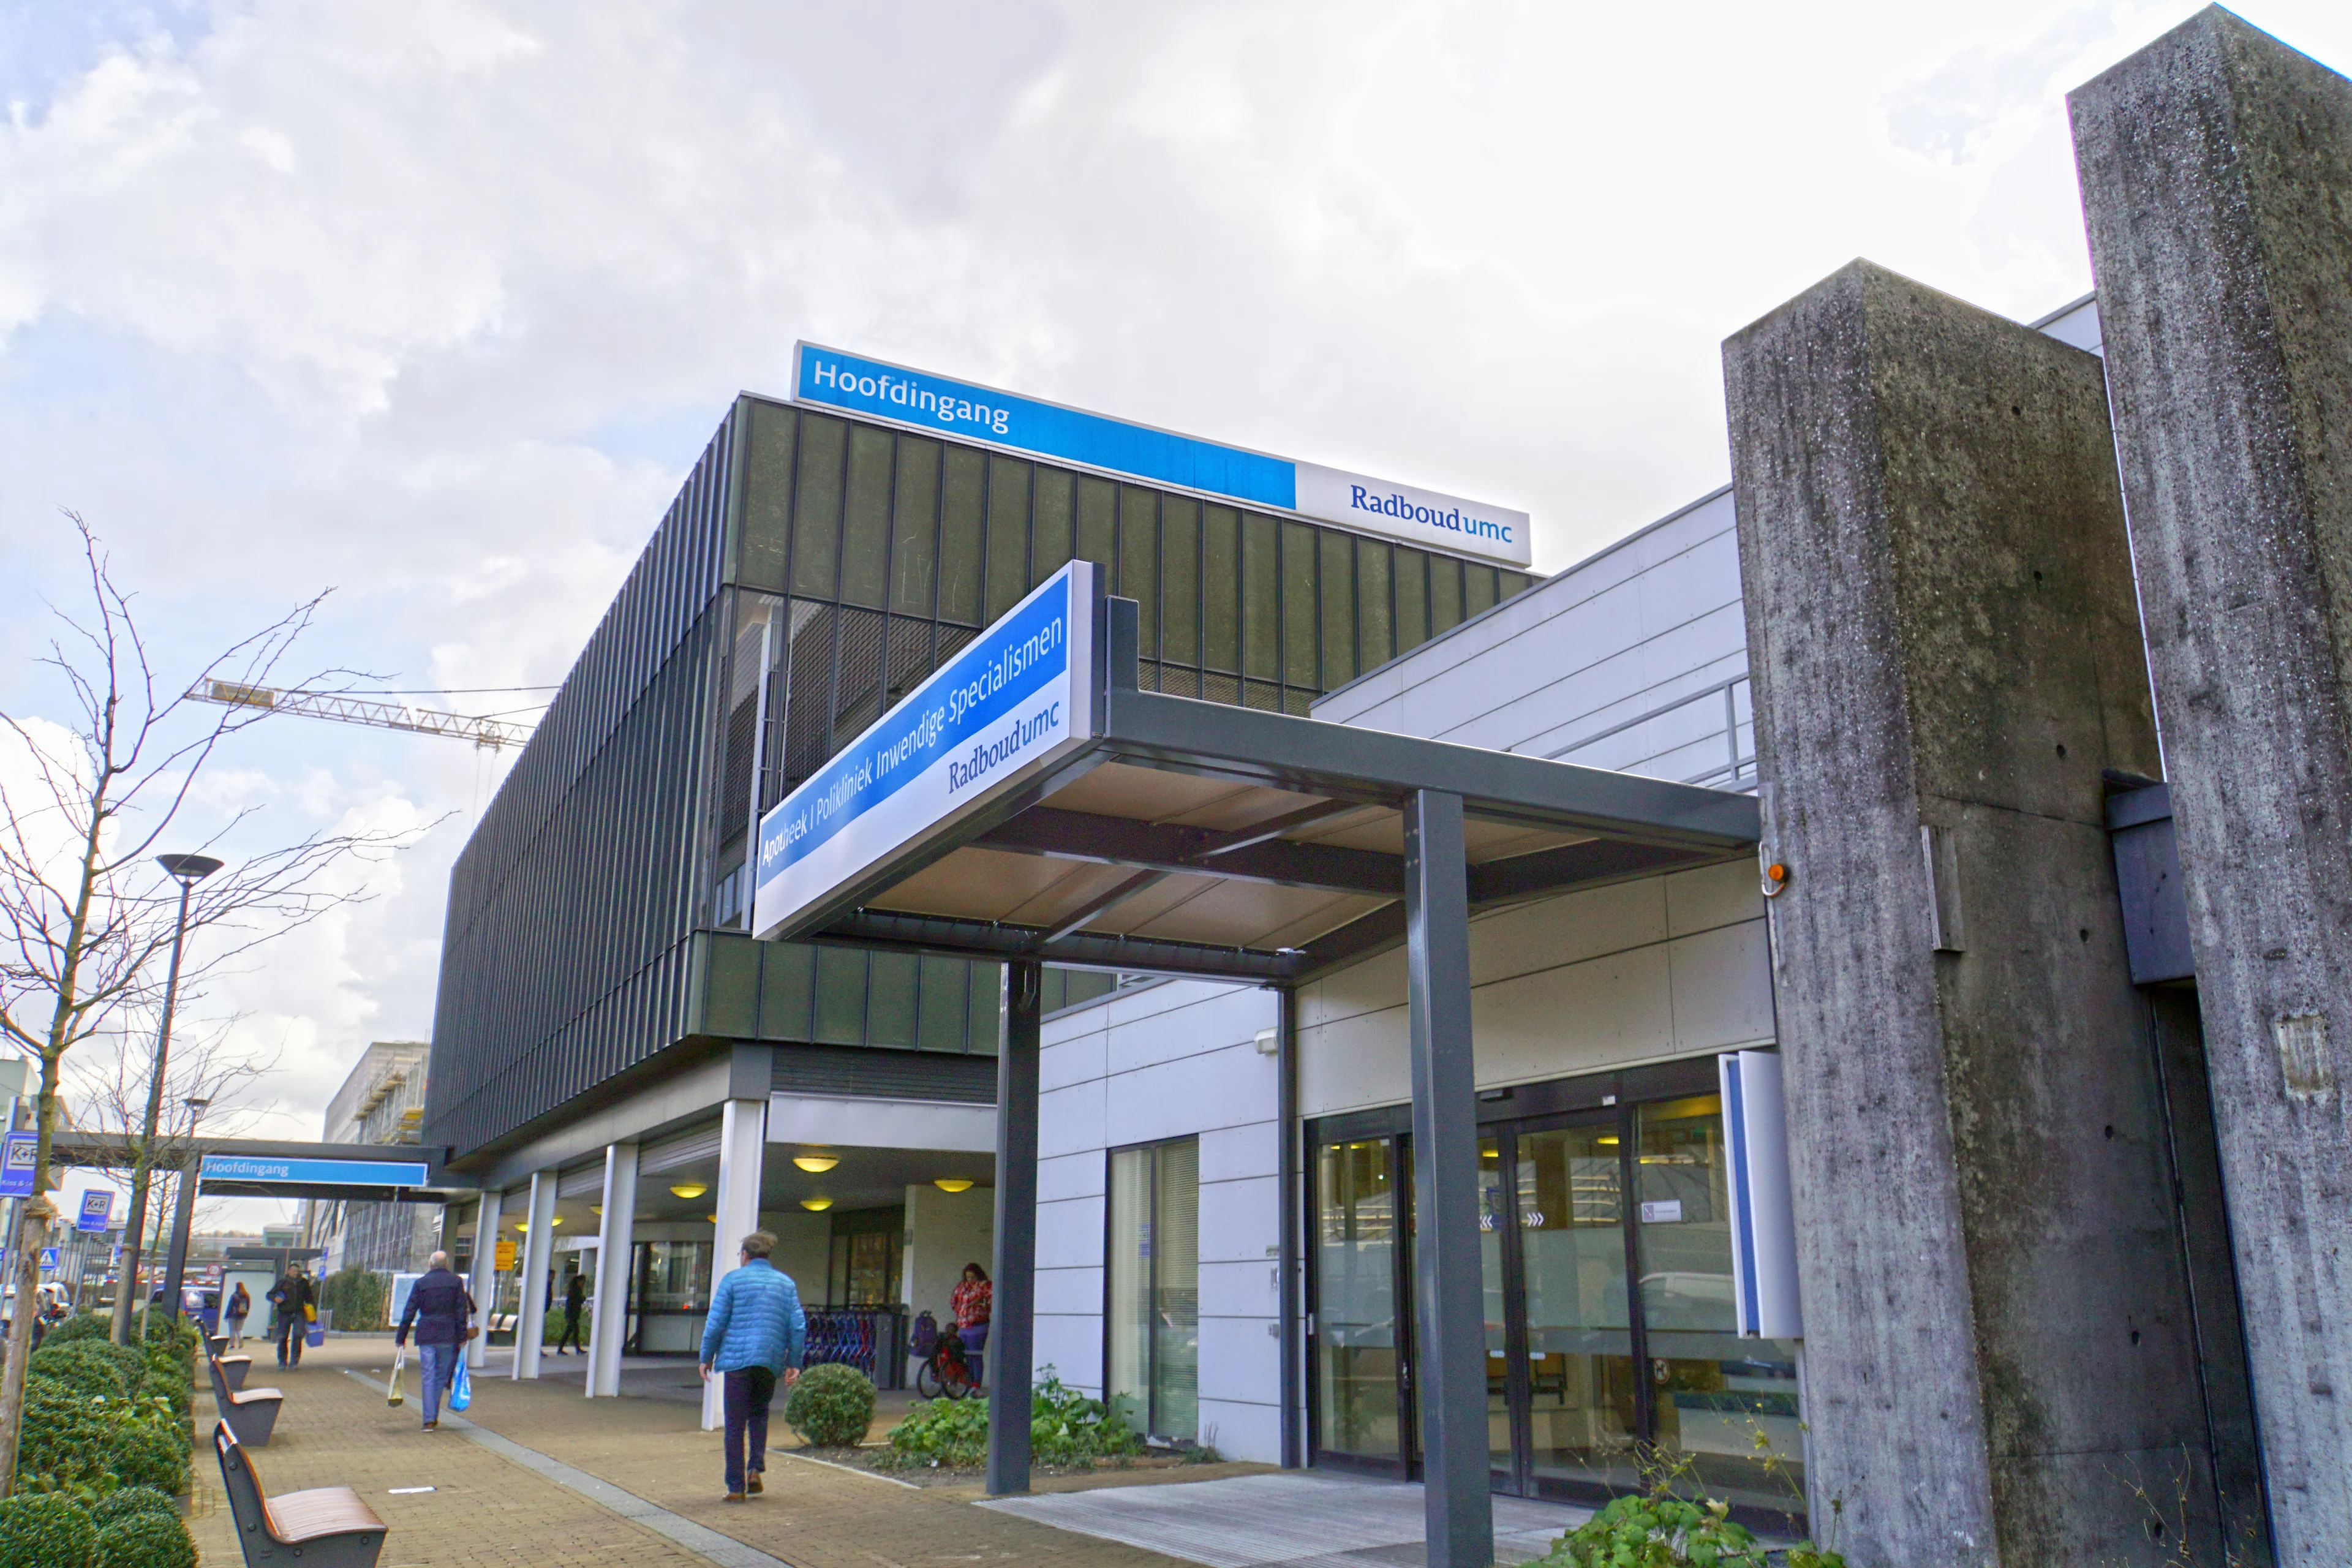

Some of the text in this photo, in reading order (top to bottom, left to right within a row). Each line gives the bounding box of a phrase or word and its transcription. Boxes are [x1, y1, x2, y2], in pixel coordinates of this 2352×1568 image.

[815, 360, 1009, 434] Hoofdingang
[1350, 484, 1512, 543] Radboudumc
[762, 809, 808, 867] Apotheek
[816, 756, 873, 826] Polikliniek
[876, 706, 945, 780] Inwendige
[949, 617, 1061, 726] Specialismen
[948, 701, 1060, 794] Radboudumc
[205, 1161, 290, 1178] Hoofdingang
[87, 1199, 106, 1209] K+R
